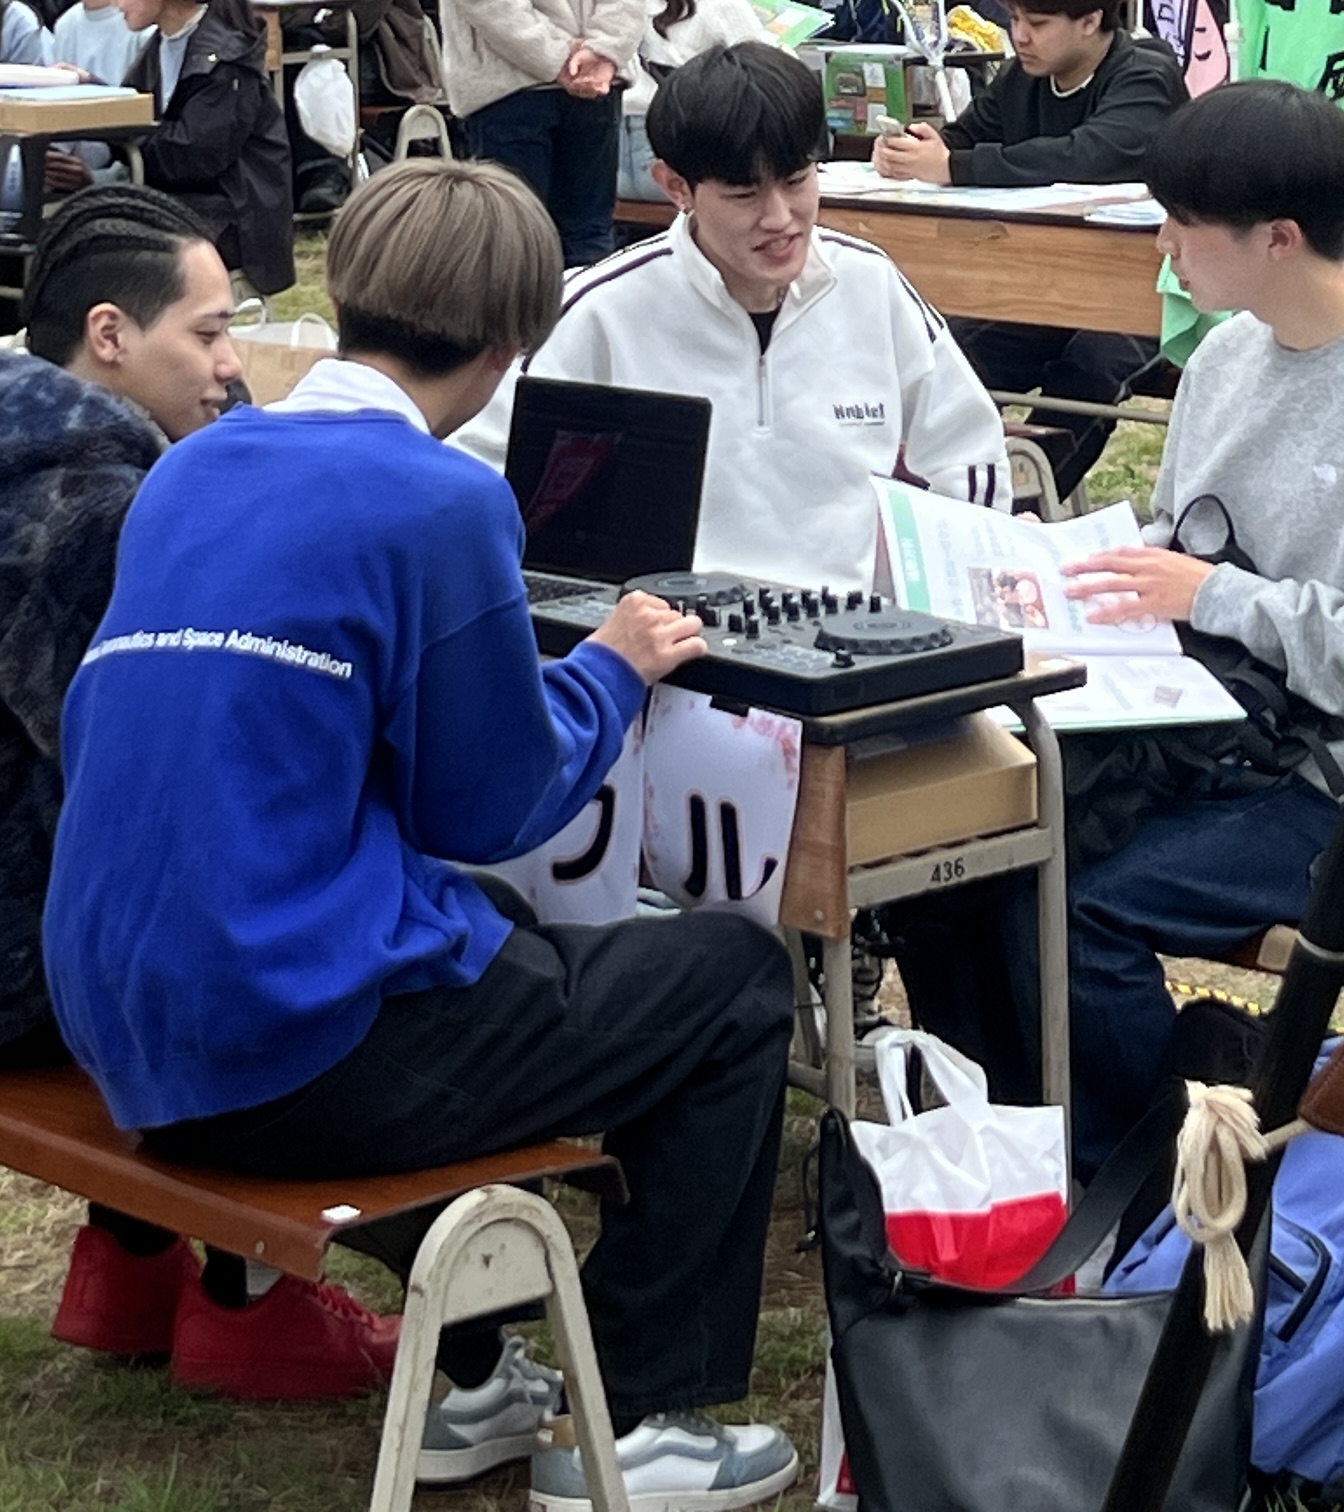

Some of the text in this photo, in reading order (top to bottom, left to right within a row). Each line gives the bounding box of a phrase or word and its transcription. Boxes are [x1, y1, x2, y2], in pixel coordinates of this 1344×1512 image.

[184, 627, 225, 651] Space
[225, 628, 353, 680] Administration
[930, 855, 966, 883] 436
